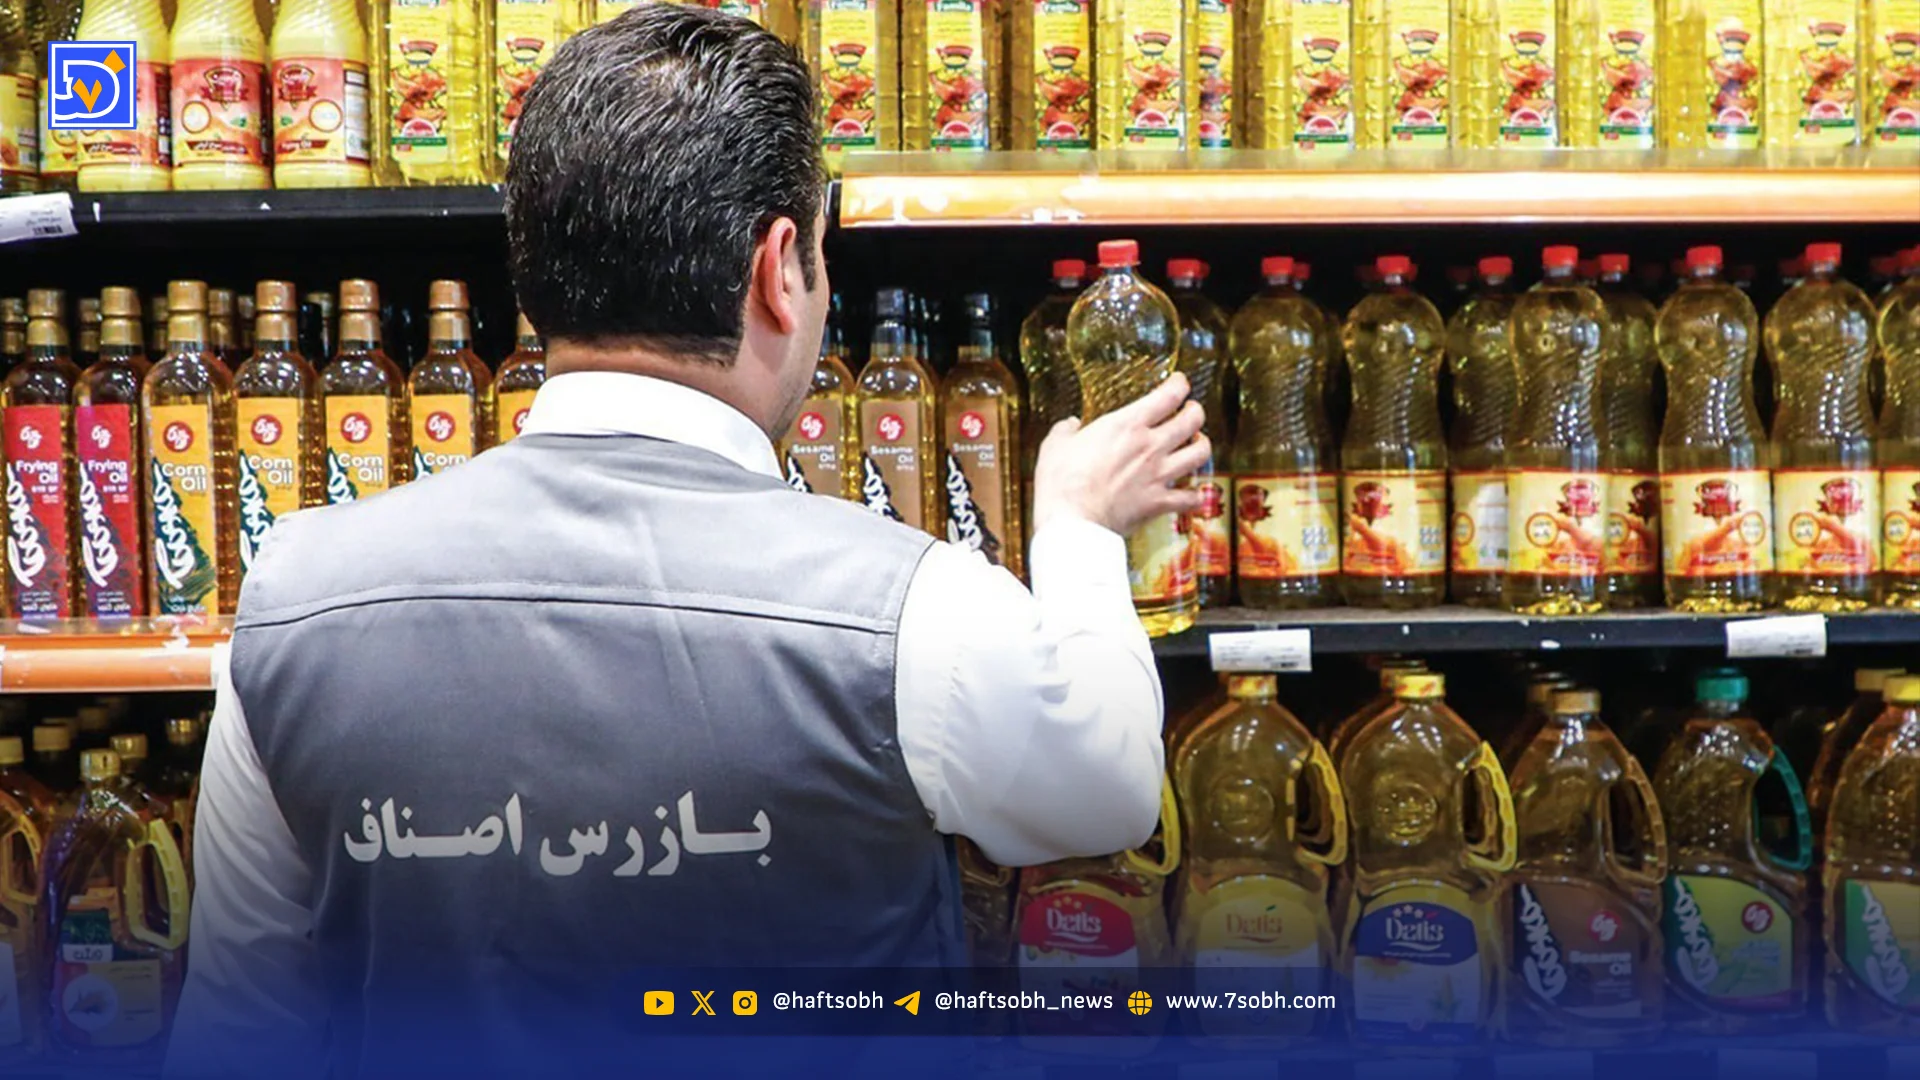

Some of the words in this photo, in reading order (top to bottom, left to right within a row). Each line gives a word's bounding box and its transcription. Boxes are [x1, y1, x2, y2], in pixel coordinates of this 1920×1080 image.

[793, 444, 835, 453] Sesame
[871, 445, 913, 455] Sesame
[953, 443, 994, 452] Sesame
[248, 455, 293, 470] Corn
[338, 453, 383, 466] Corn
[423, 452, 466, 466] Corn
[16, 459, 58, 474] Frying
[88, 459, 127, 474] Frying
[162, 463, 206, 477] Corn
[39, 472, 58, 484] Oil
[109, 472, 127, 483] Oil
[267, 469, 293, 484] Oil
[358, 467, 383, 481] Oil
[181, 476, 206, 491] Oil
[154, 463, 196, 589] Tooska
[344, 793, 523, 861] اصناف
[540, 790, 771, 876] بازرس
[1569, 951, 1631, 963] Sesame
[1609, 962, 1631, 975] Oil
